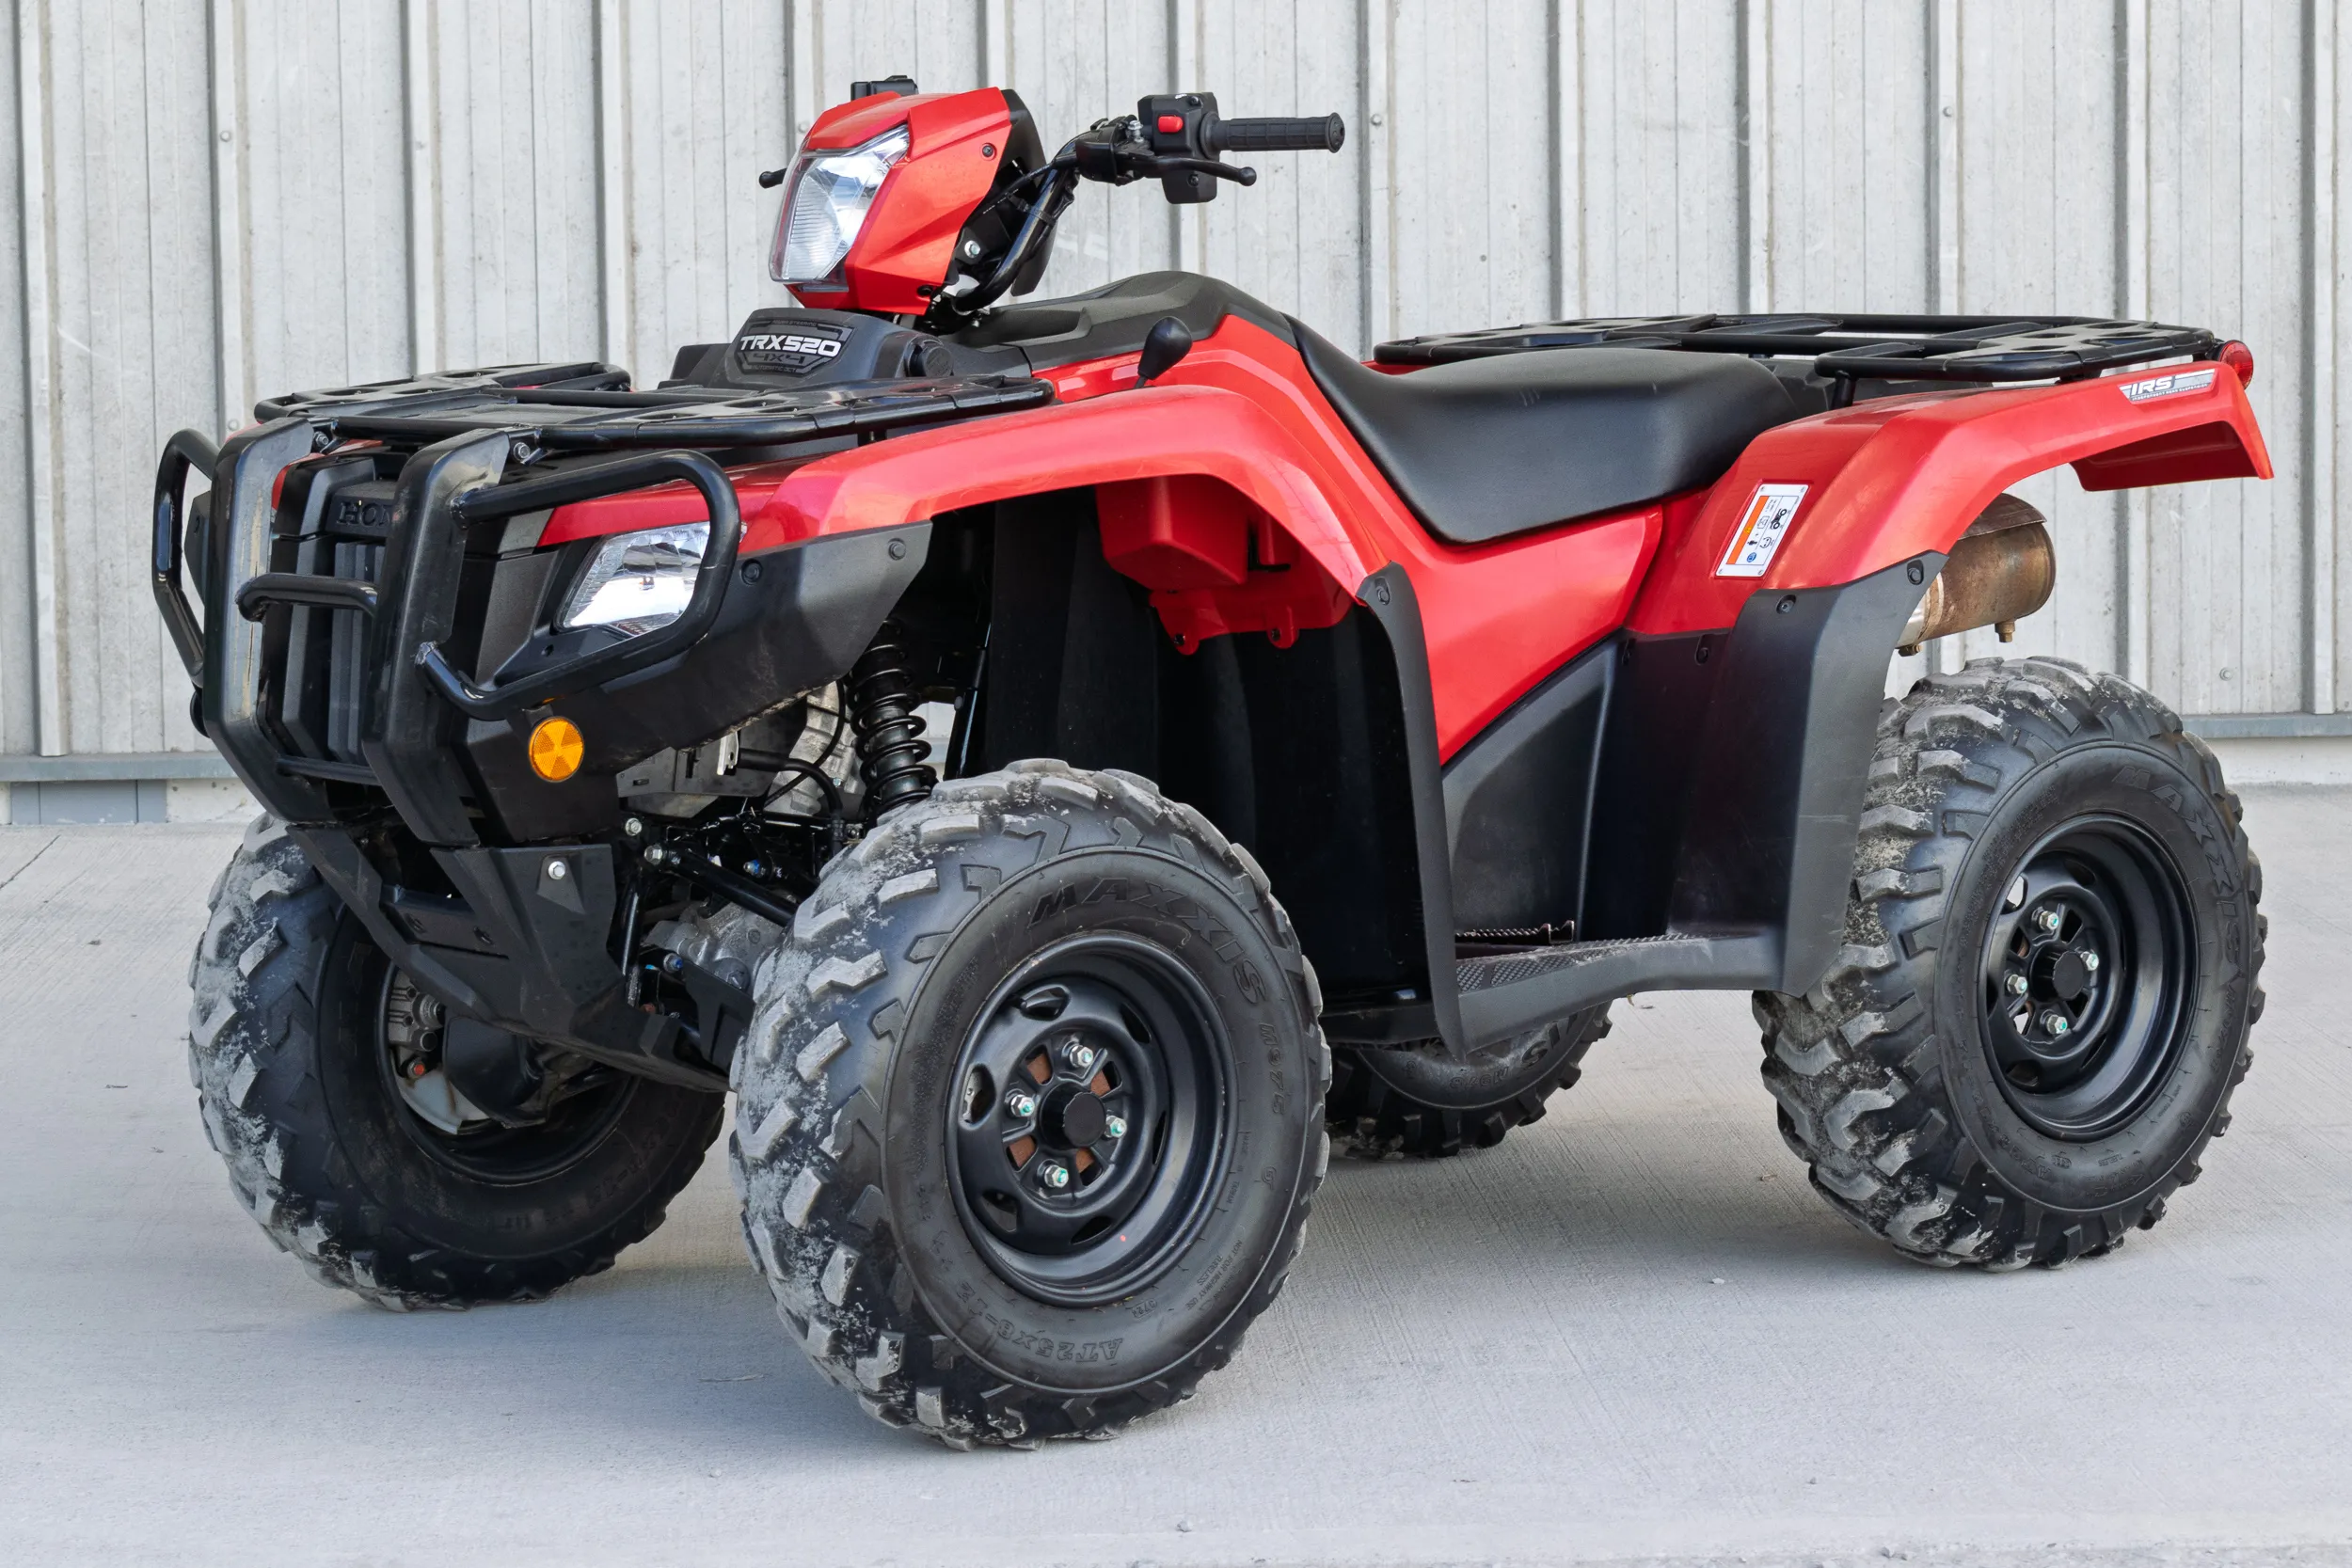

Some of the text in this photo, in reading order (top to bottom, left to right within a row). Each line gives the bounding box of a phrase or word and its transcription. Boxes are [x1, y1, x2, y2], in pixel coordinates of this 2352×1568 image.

[740, 335, 841, 356] TRX520
[2130, 376, 2173, 395] IRS
[2112, 766, 2238, 963] MAXXIS
[1026, 878, 1267, 1006] MAXXIS
[1259, 1023, 1285, 1116] M975
[1232, 1240, 1243, 1257] NOT
[1222, 1256, 1234, 1273] FOR
